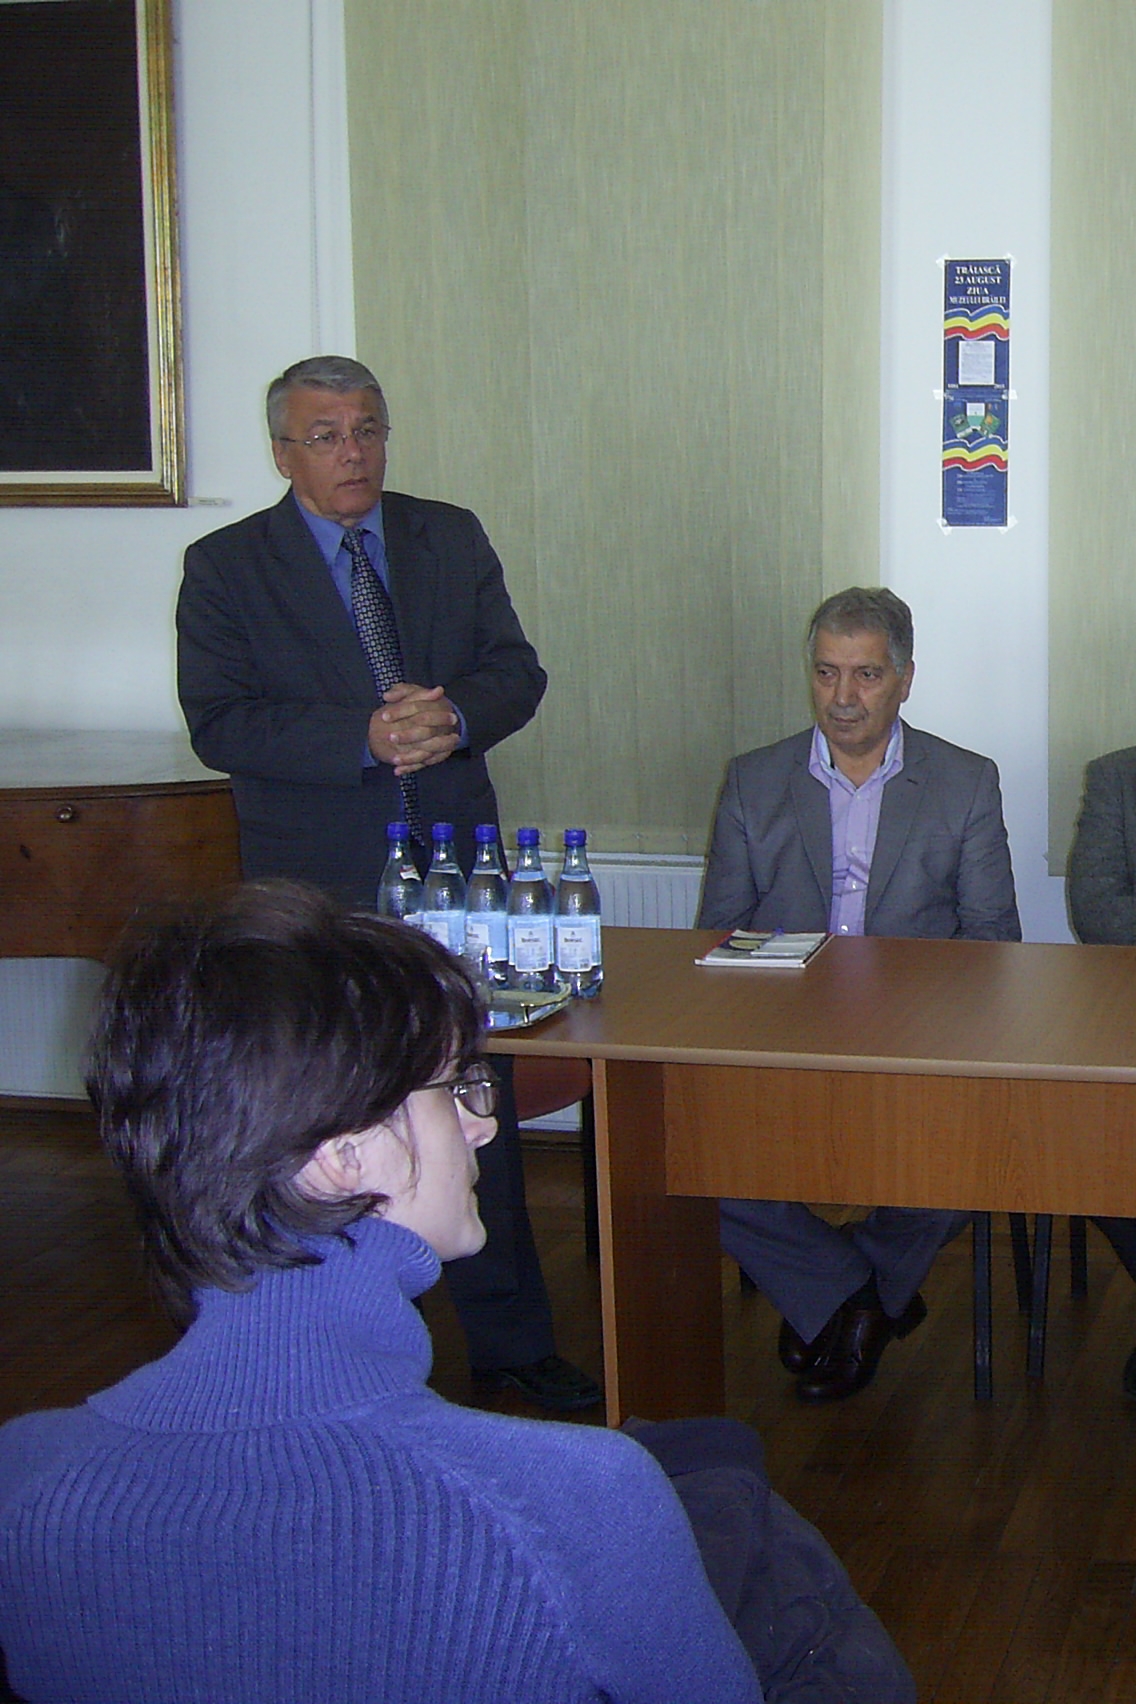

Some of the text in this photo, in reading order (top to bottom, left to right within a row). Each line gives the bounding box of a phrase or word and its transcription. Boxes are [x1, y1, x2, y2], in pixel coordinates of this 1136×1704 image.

[954, 276, 1002, 285] 23 AUGUST
[966, 286, 989, 295] ZIUA
